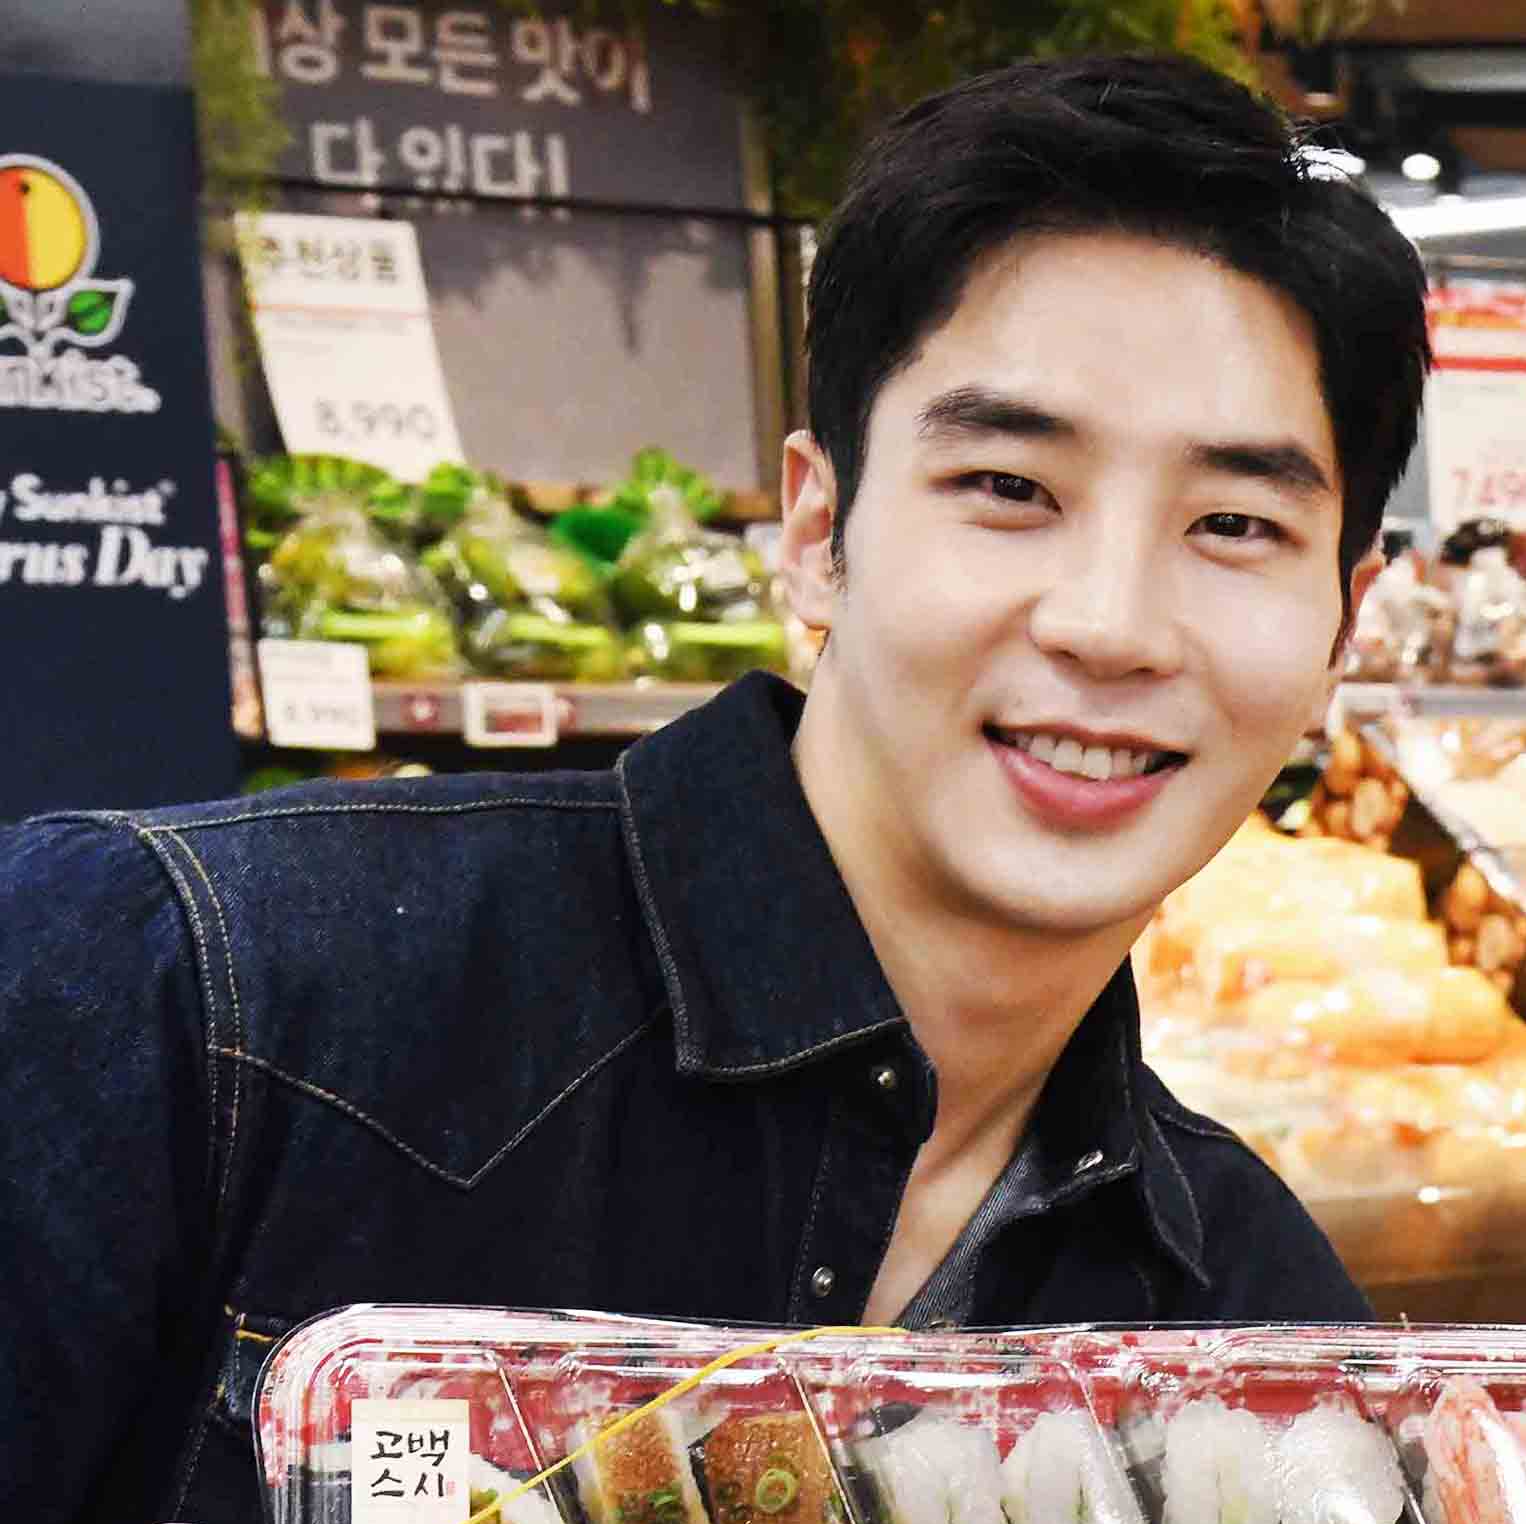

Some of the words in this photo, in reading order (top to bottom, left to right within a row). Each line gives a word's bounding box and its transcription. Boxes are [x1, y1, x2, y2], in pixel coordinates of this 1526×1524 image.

[360, 4, 499, 98] 모든
[511, 16, 651, 114] 맛이
[0, 540, 88, 585] rus
[94, 523, 208, 599] Day
[371, 1429, 450, 1466] 고백
[371, 1469, 445, 1498] 스시
